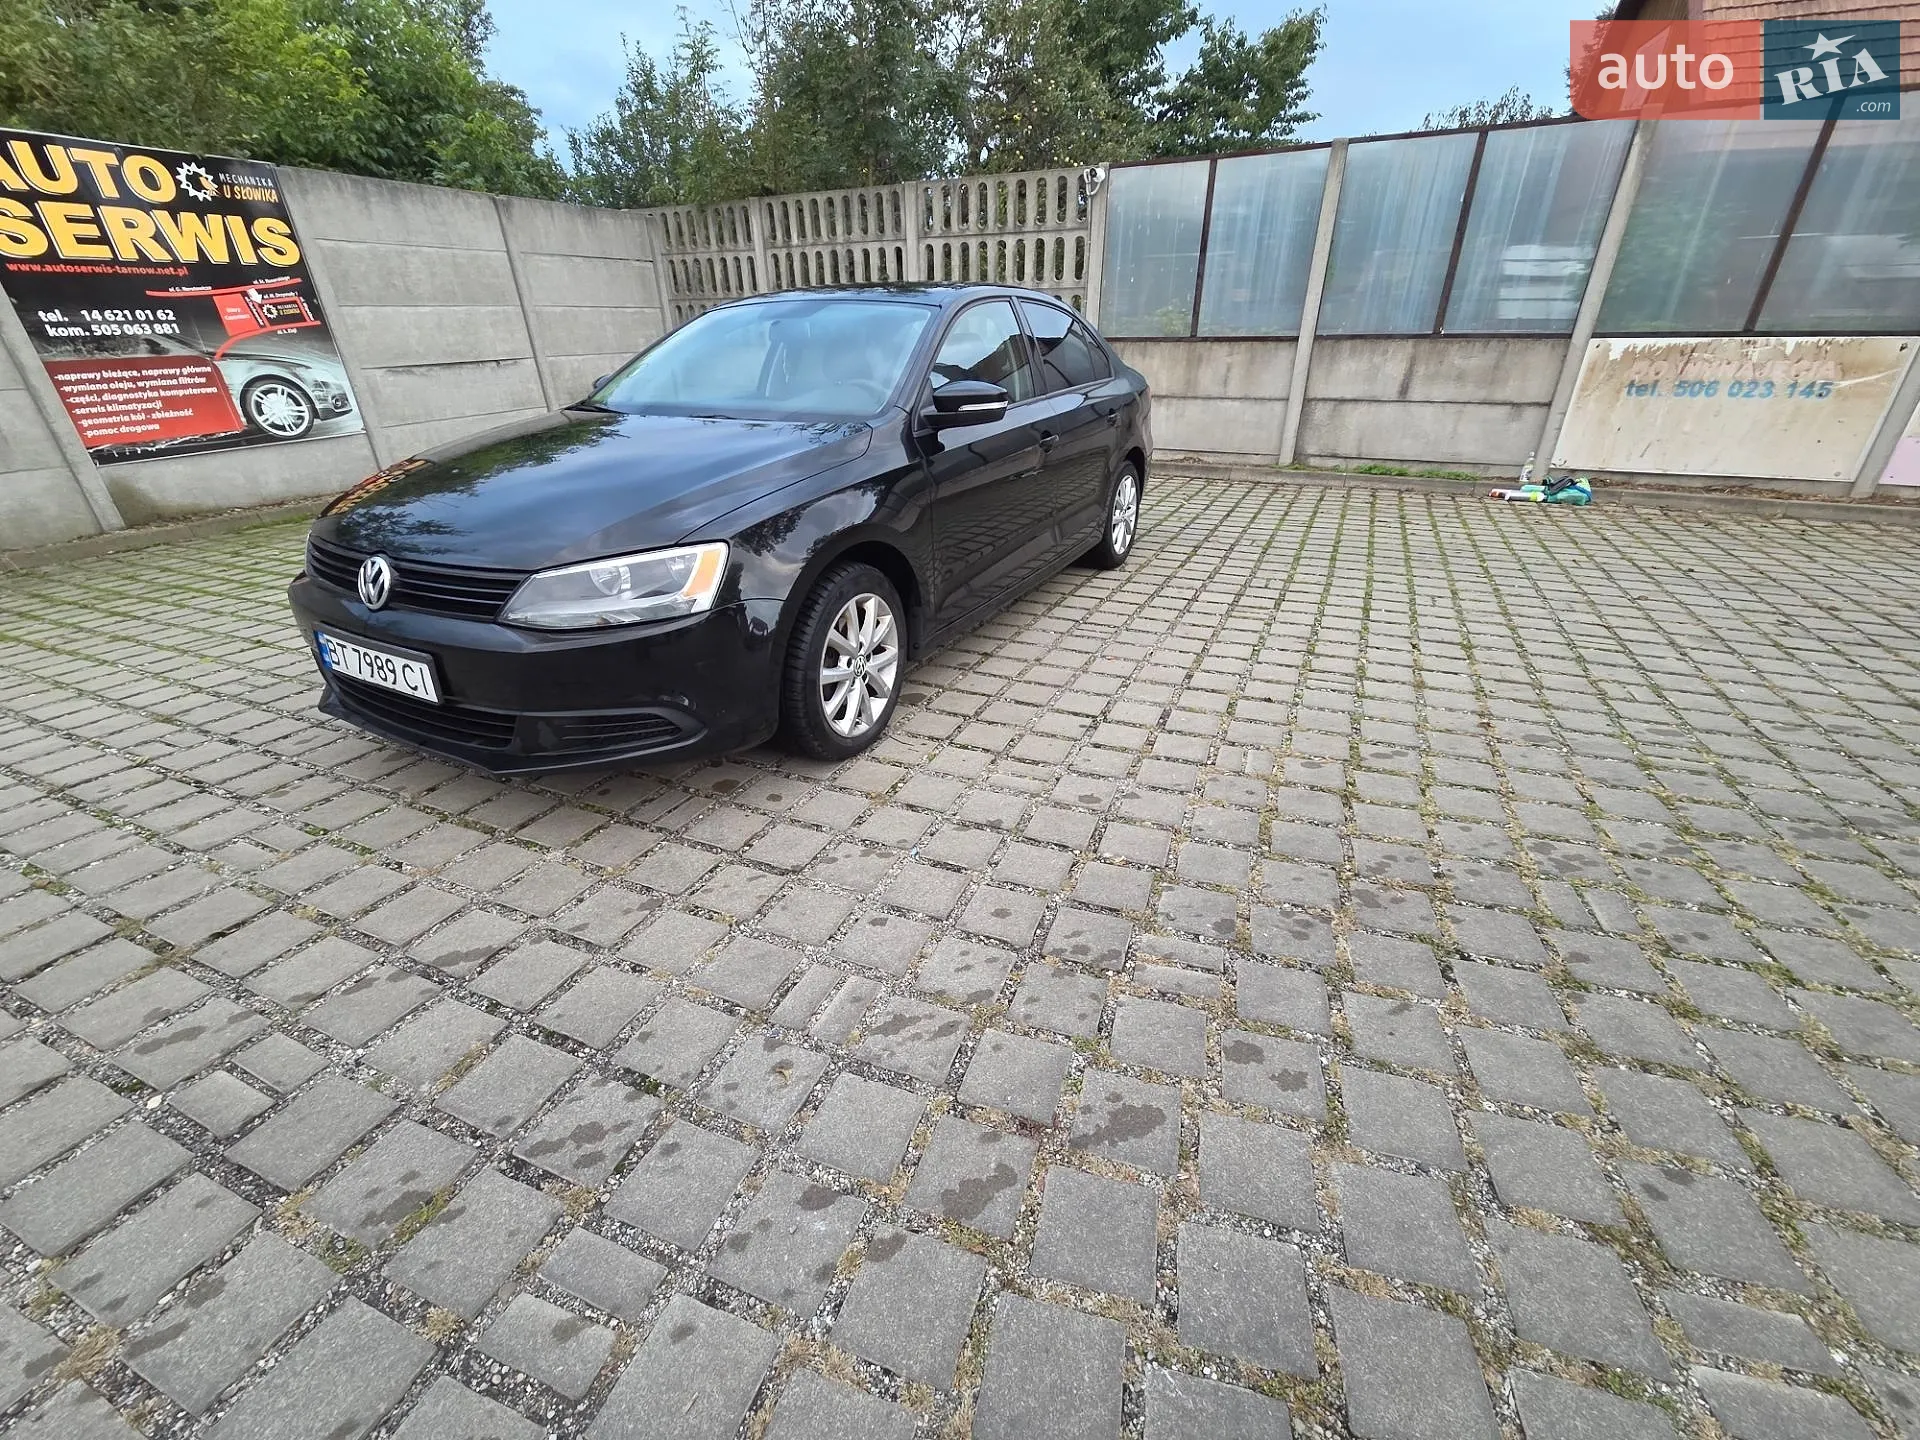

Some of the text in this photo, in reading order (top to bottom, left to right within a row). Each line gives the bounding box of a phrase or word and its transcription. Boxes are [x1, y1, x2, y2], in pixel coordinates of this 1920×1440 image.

[219, 173, 274, 188] MECHANIKA
[222, 184, 279, 203] U SŁOWIKA
[0, 197, 300, 267] SERWIS
[6, 262, 189, 277] www.autoserwis-tarnow.net.pl
[38, 309, 177, 323] tel. 14 621 01 62
[44, 323, 181, 337] kom. 505 063 881
[141, 367, 181, 376] naprawy
[181, 365, 212, 375] główne
[109, 380, 136, 391] oleju,
[136, 378, 178, 388] wymiana
[178, 375, 207, 385] filtrów
[1626, 378, 1834, 399] tel. 506 023 145
[101, 390, 159, 401] diagnostyka
[159, 386, 218, 397] komputerowa
[106, 399, 163, 412] klimatyzacji
[130, 412, 146, 421] kół
[151, 408, 194, 420] zbieżność
[120, 423, 160, 434] drogowa
[325, 638, 429, 696] BT 7989 CI
